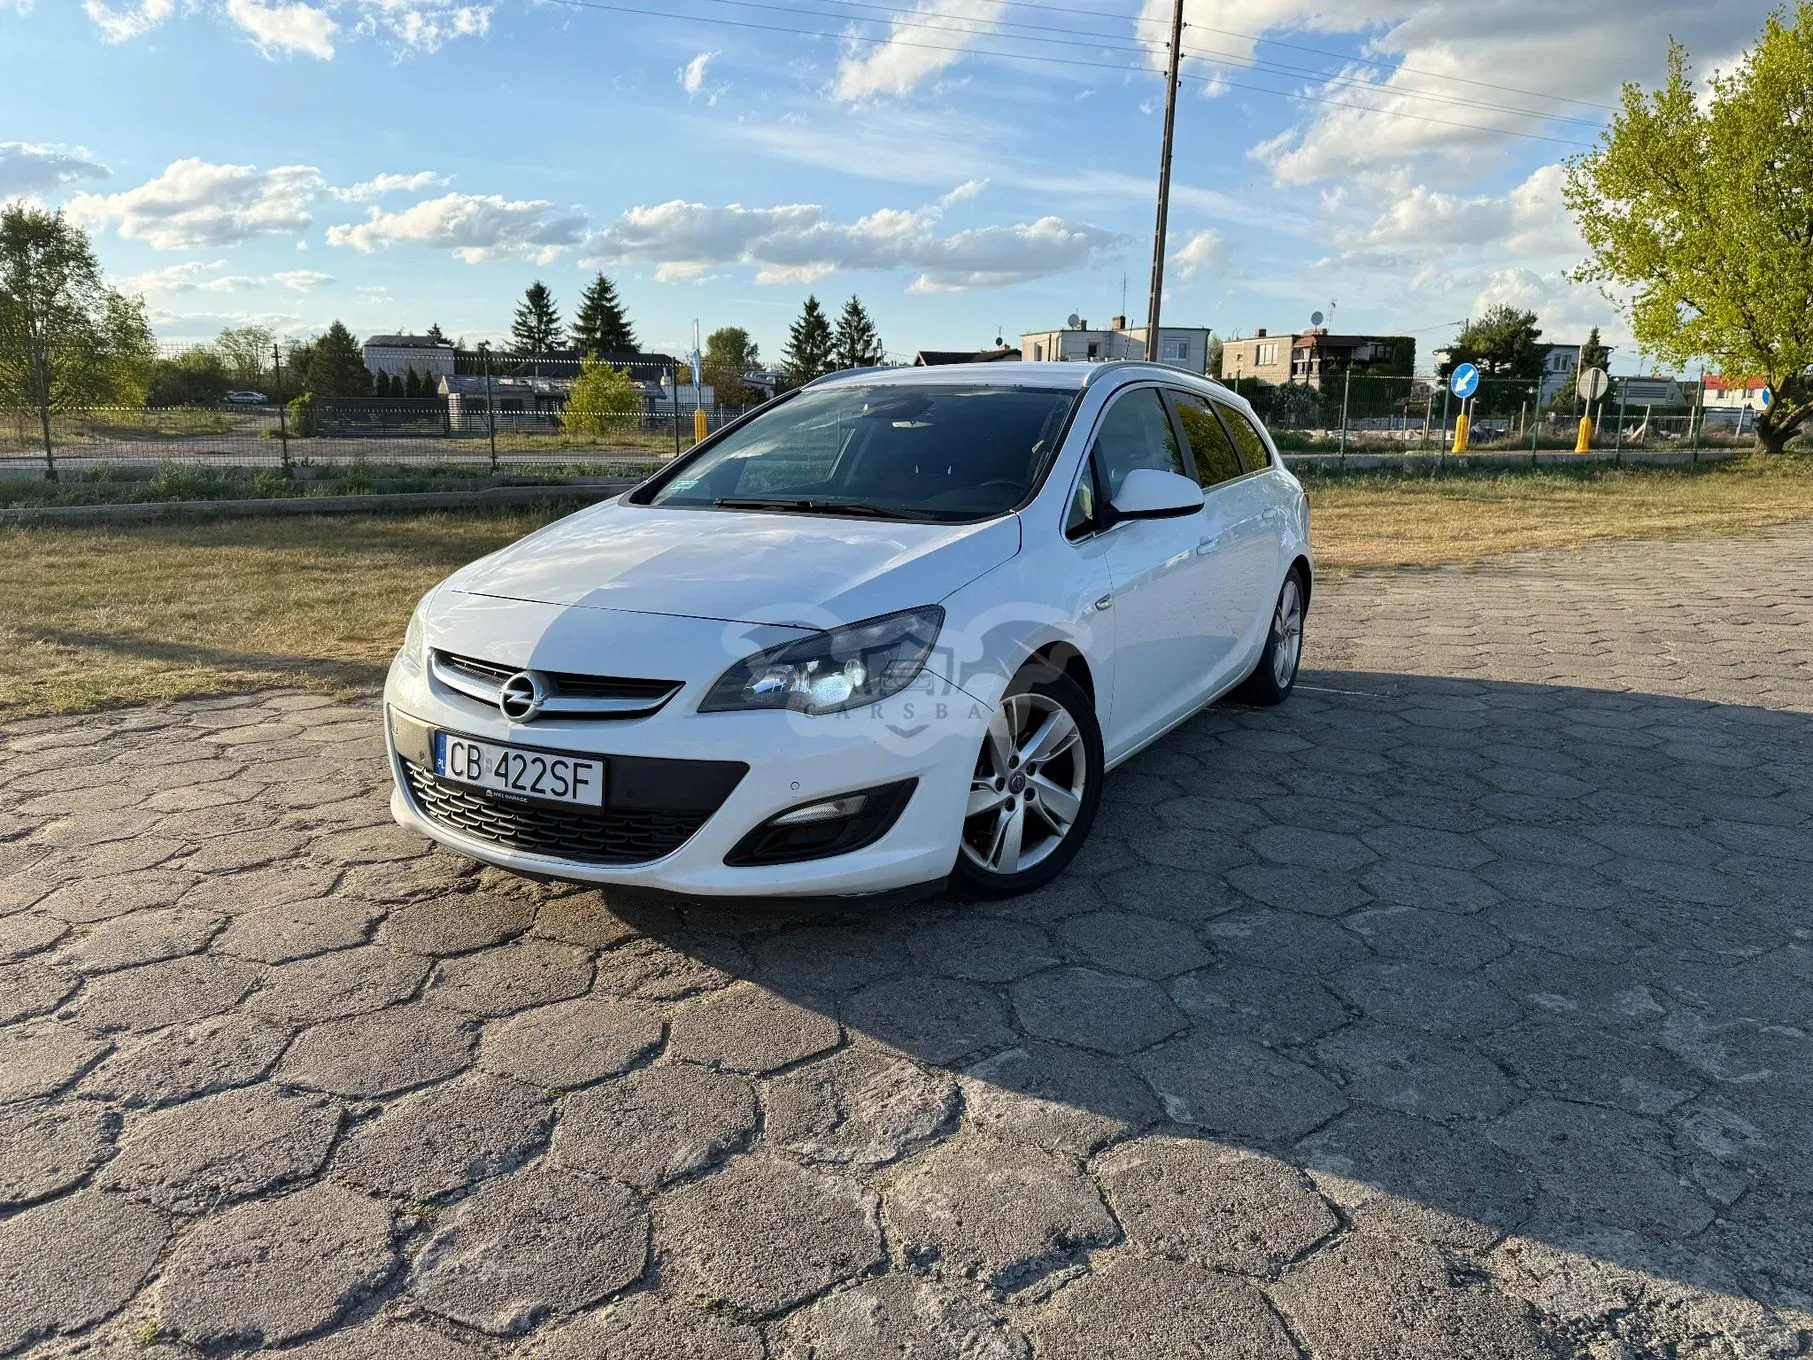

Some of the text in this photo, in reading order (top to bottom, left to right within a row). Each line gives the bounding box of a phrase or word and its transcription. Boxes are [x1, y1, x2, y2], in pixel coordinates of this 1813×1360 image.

[437, 758, 445, 769] PL
[451, 741, 593, 799] CB 422SF
